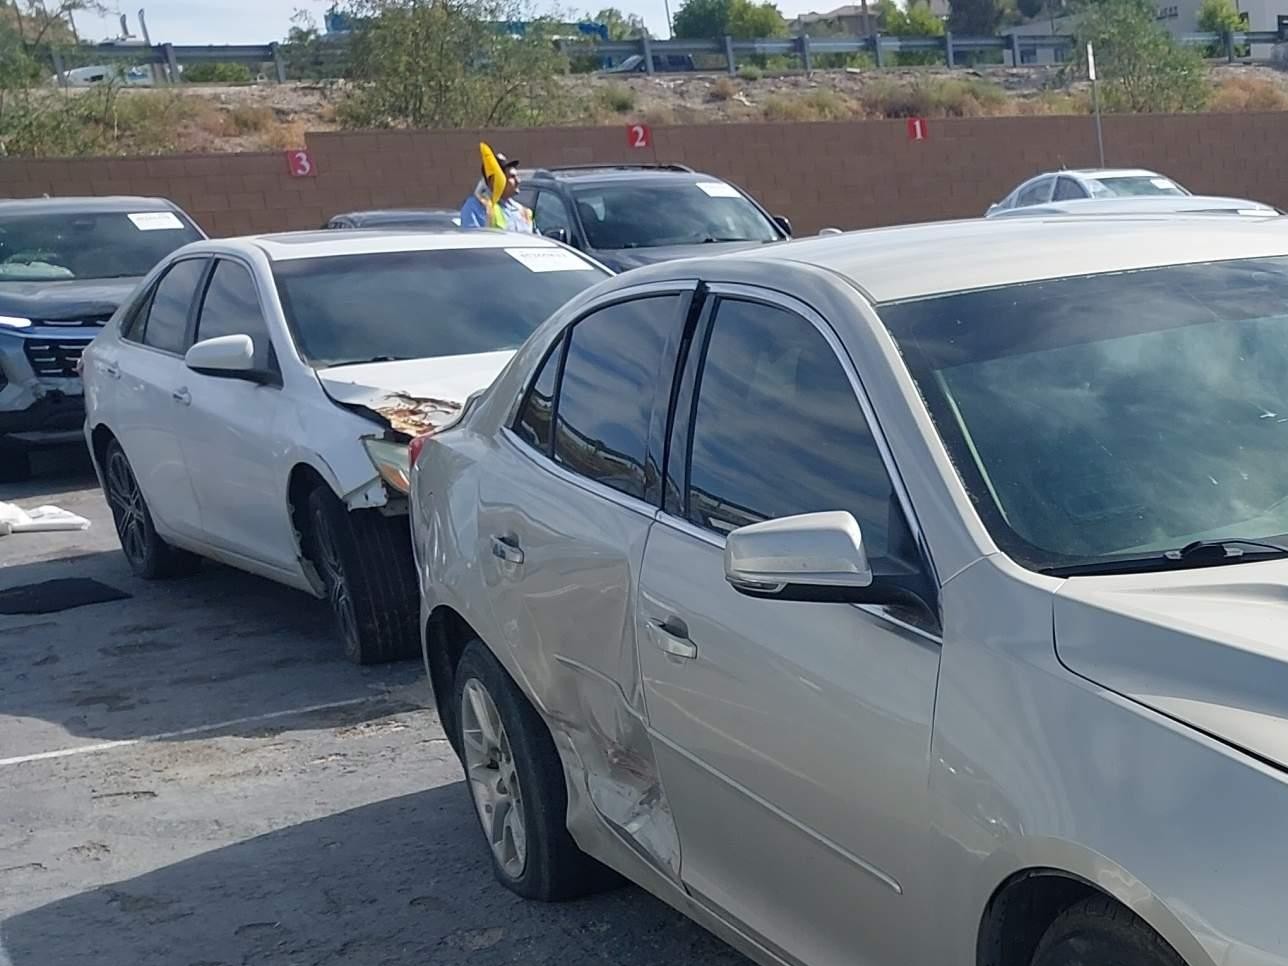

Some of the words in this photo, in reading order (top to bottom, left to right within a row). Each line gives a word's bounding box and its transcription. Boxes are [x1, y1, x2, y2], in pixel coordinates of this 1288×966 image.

[632, 126, 646, 147] 2
[914, 120, 923, 140] 1
[296, 152, 310, 175] 3
